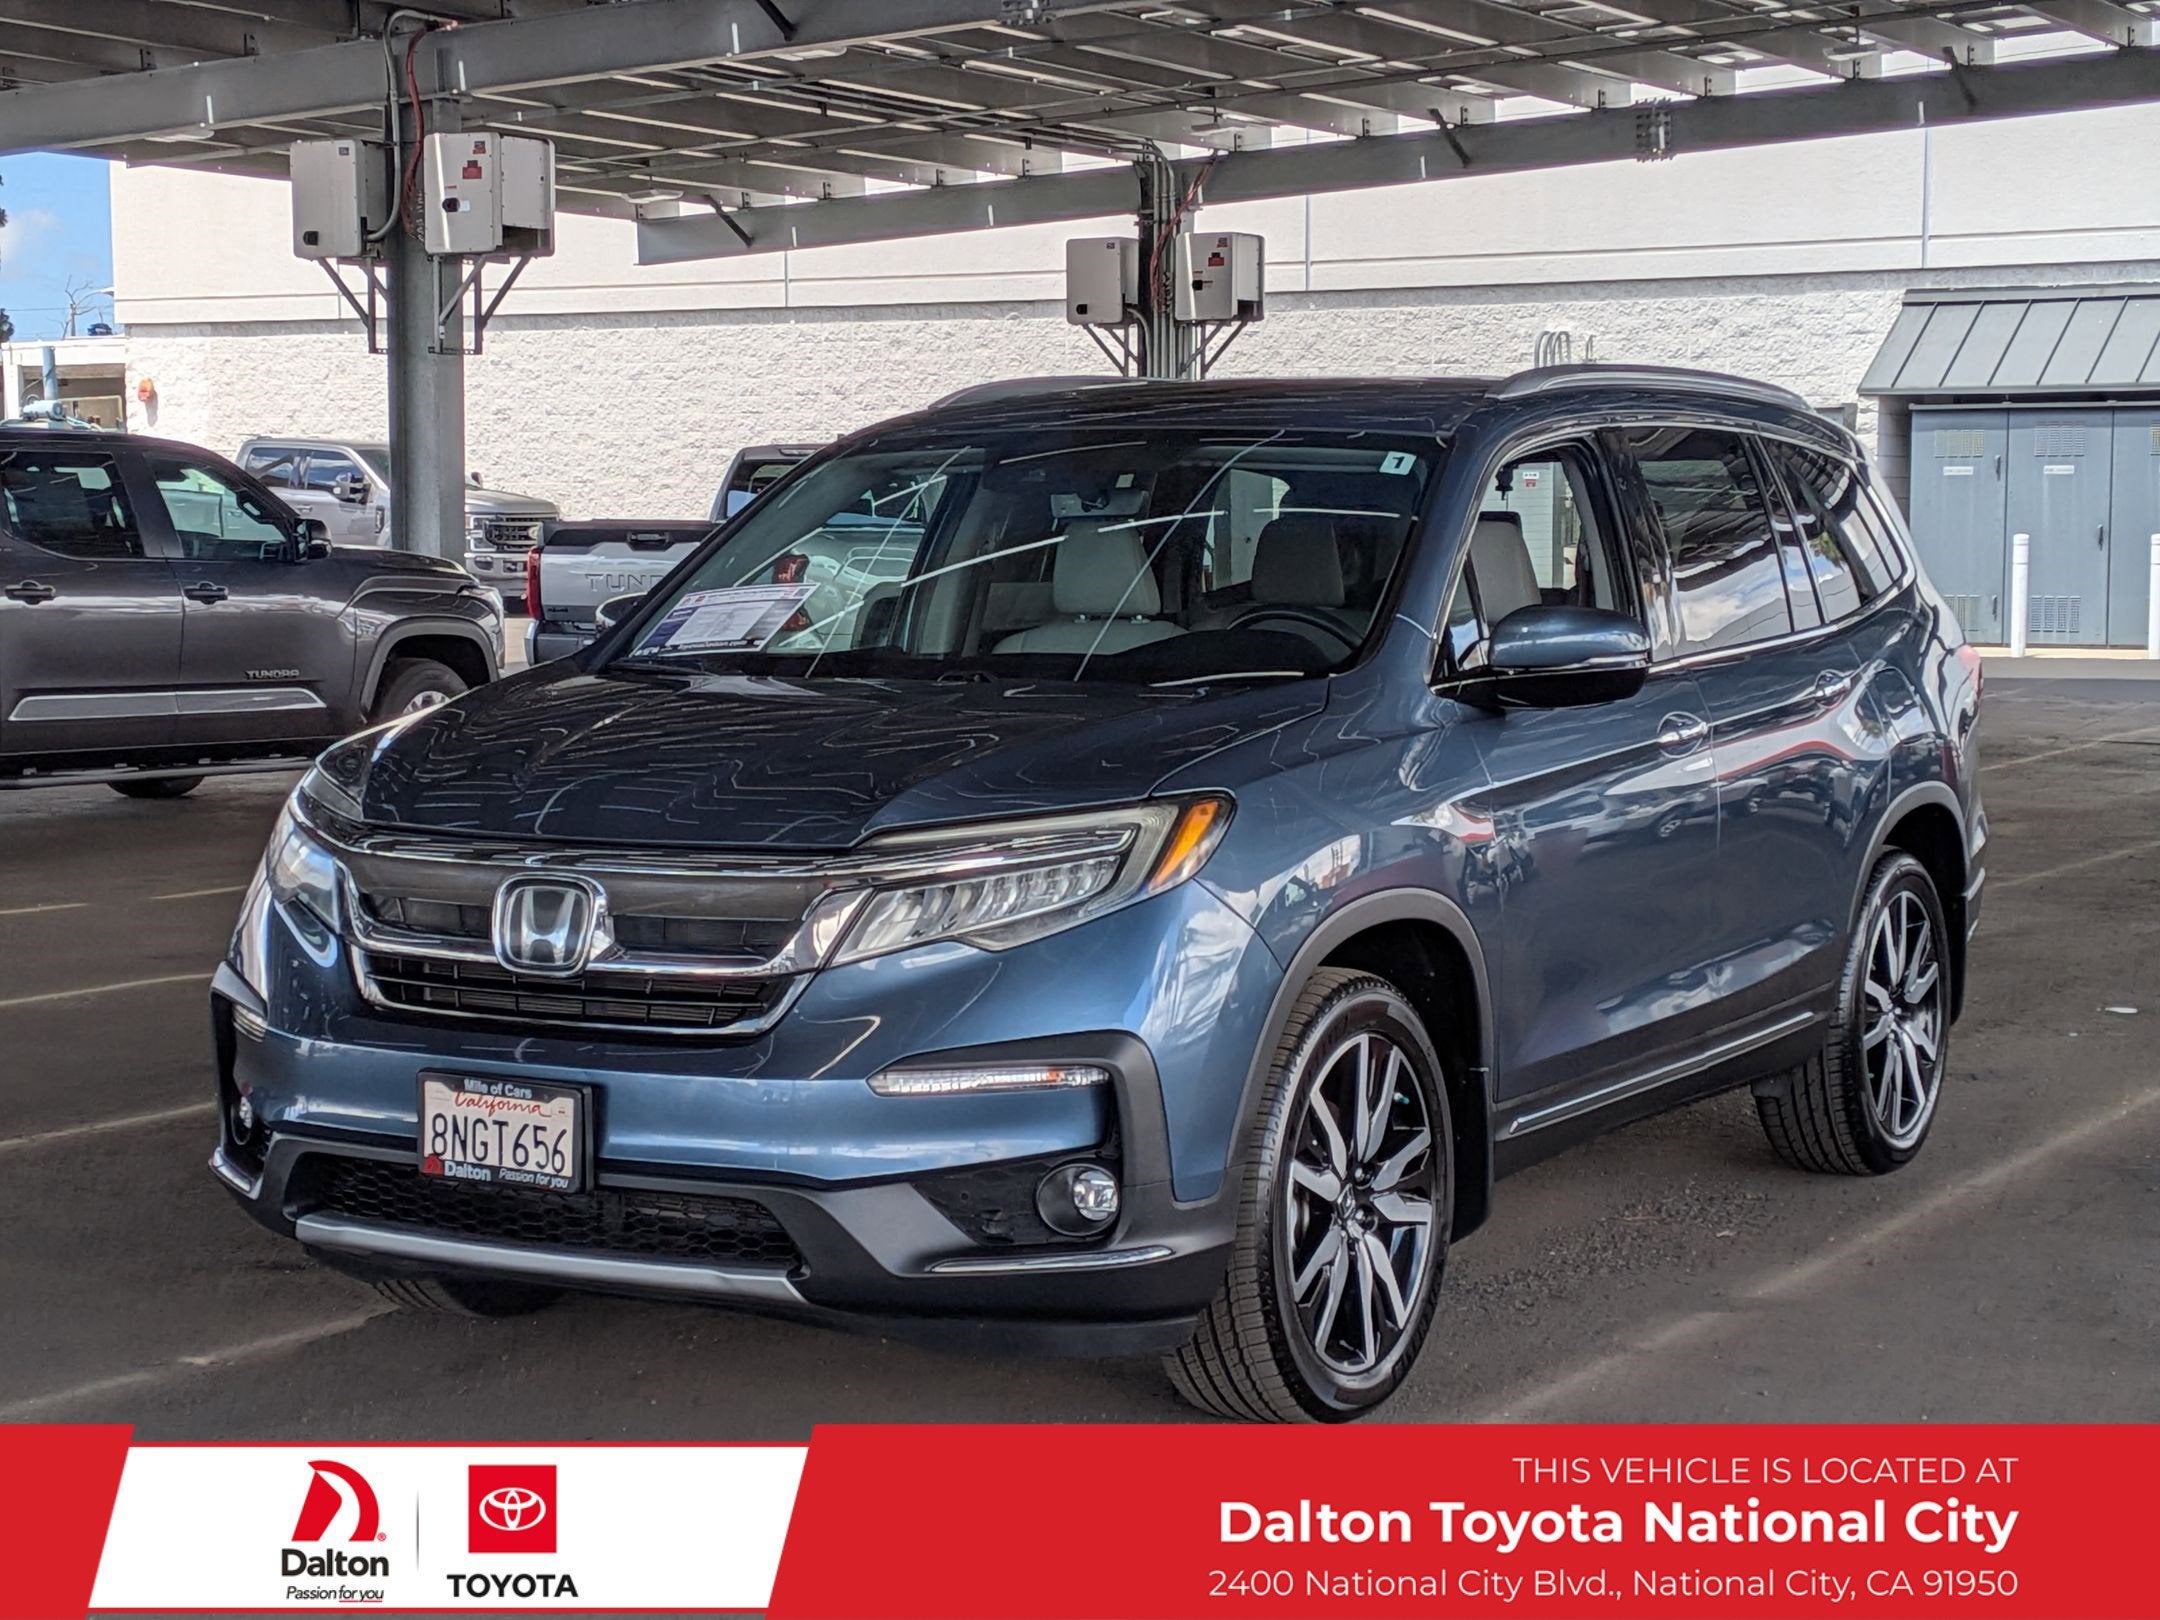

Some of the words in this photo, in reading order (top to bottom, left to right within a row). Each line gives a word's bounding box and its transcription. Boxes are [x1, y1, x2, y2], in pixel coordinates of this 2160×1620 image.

[464, 1078, 488, 1093] Mile
[490, 1083, 503, 1095] of
[504, 1084, 532, 1099] Cars
[455, 1089, 552, 1117] California
[431, 1112, 568, 1174] 8NGT656
[444, 1161, 492, 1181] Dalton
[499, 1168, 534, 1183] Passion
[535, 1169, 550, 1185] for
[550, 1175, 569, 1189] you
